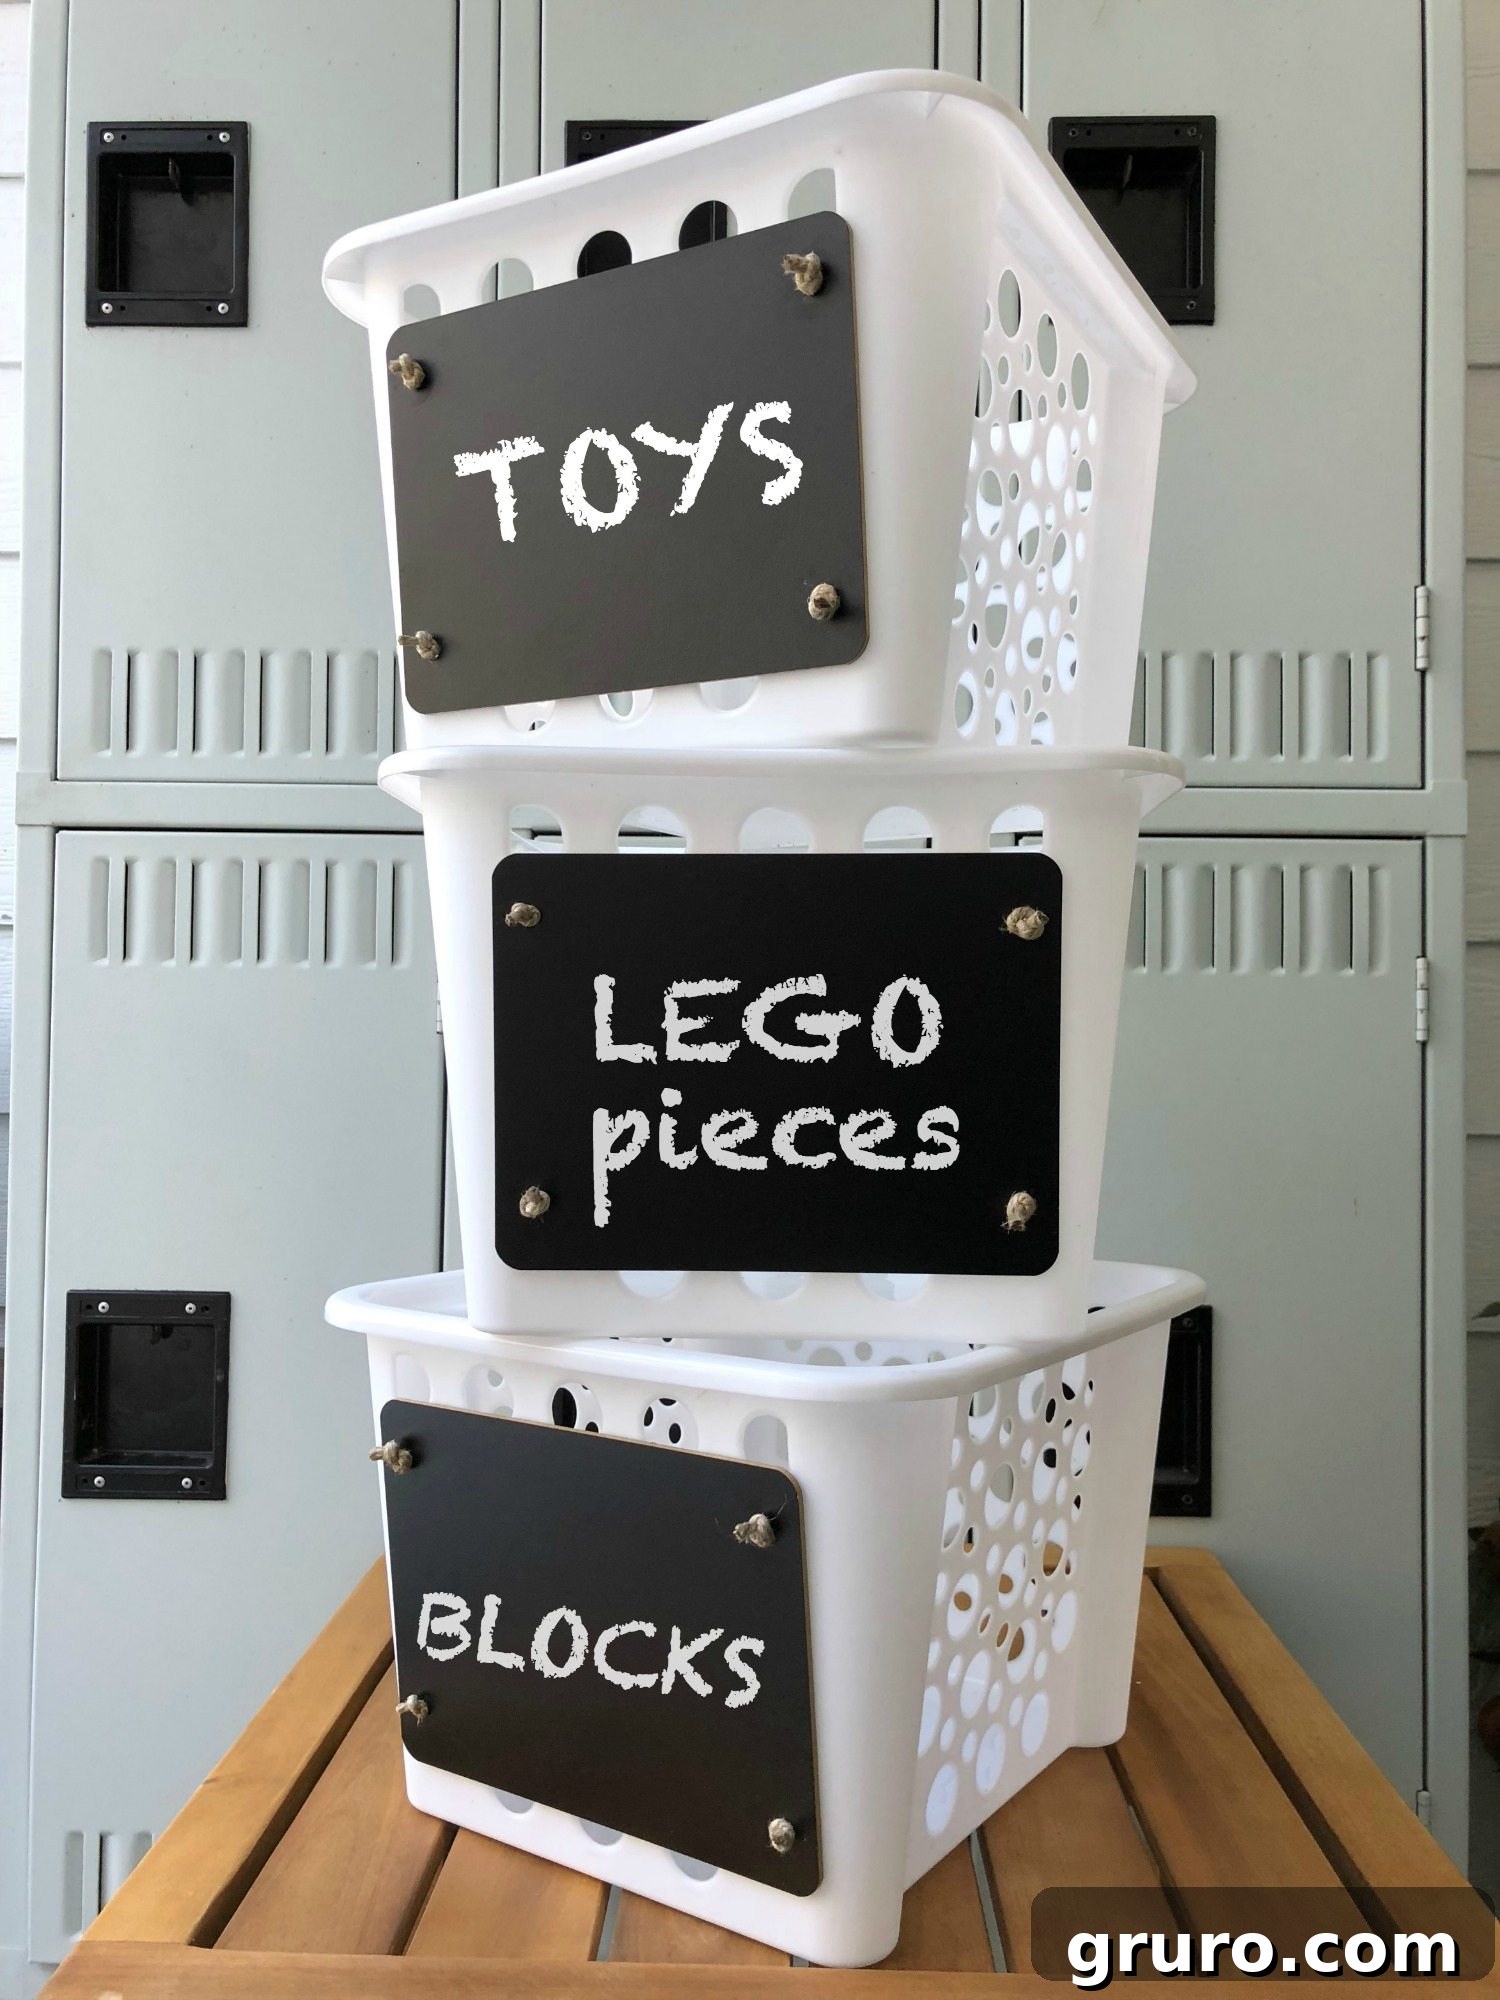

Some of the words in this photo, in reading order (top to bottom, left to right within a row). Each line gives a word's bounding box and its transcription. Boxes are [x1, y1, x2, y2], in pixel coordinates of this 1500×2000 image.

[453, 401, 803, 543] TOYS
[594, 974, 942, 1068] LEGO
[593, 1088, 960, 1228] pieces
[417, 1592, 765, 1708] BLOCKS
